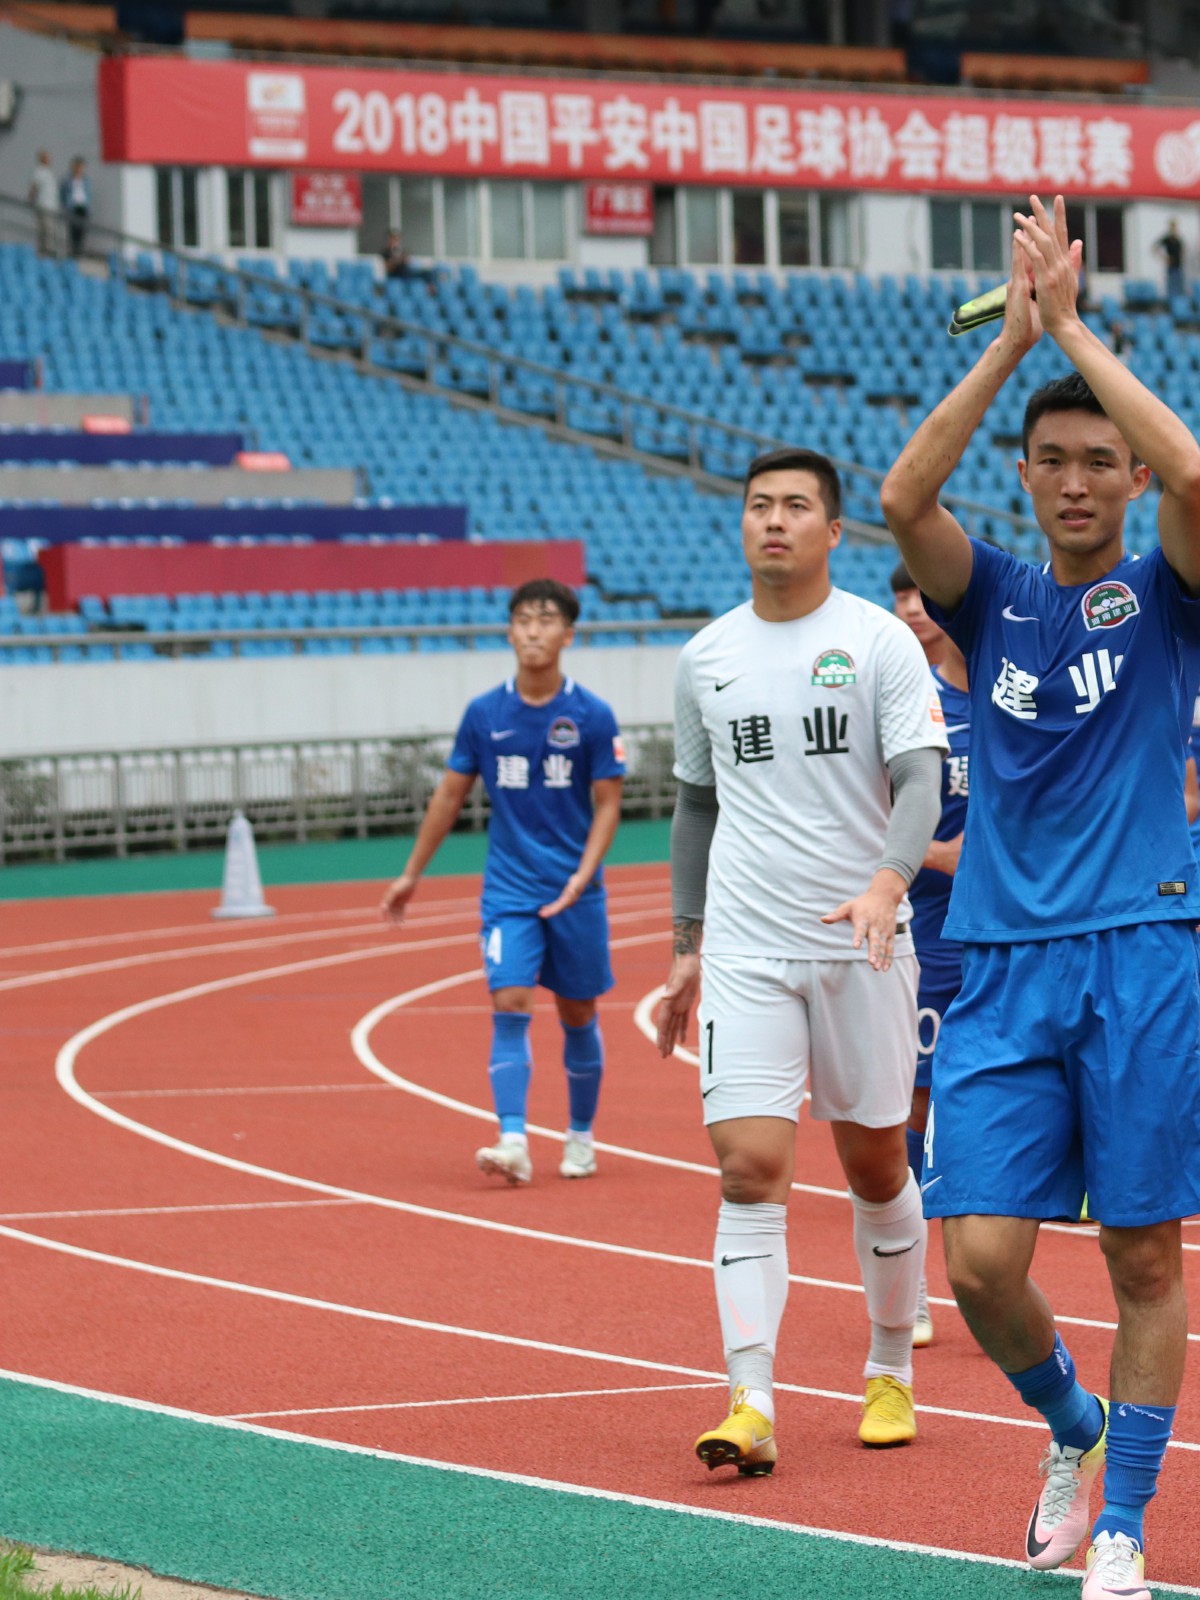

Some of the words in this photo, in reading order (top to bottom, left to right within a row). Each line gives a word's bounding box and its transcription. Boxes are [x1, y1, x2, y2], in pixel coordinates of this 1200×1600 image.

[332, 88, 1133, 190] 2018中国平安中国足球协会超级联赛
[991, 648, 1124, 720] 建业
[728, 706, 849, 766] 建业
[496, 754, 573, 789] 建业
[706, 1019, 714, 1074] 1
